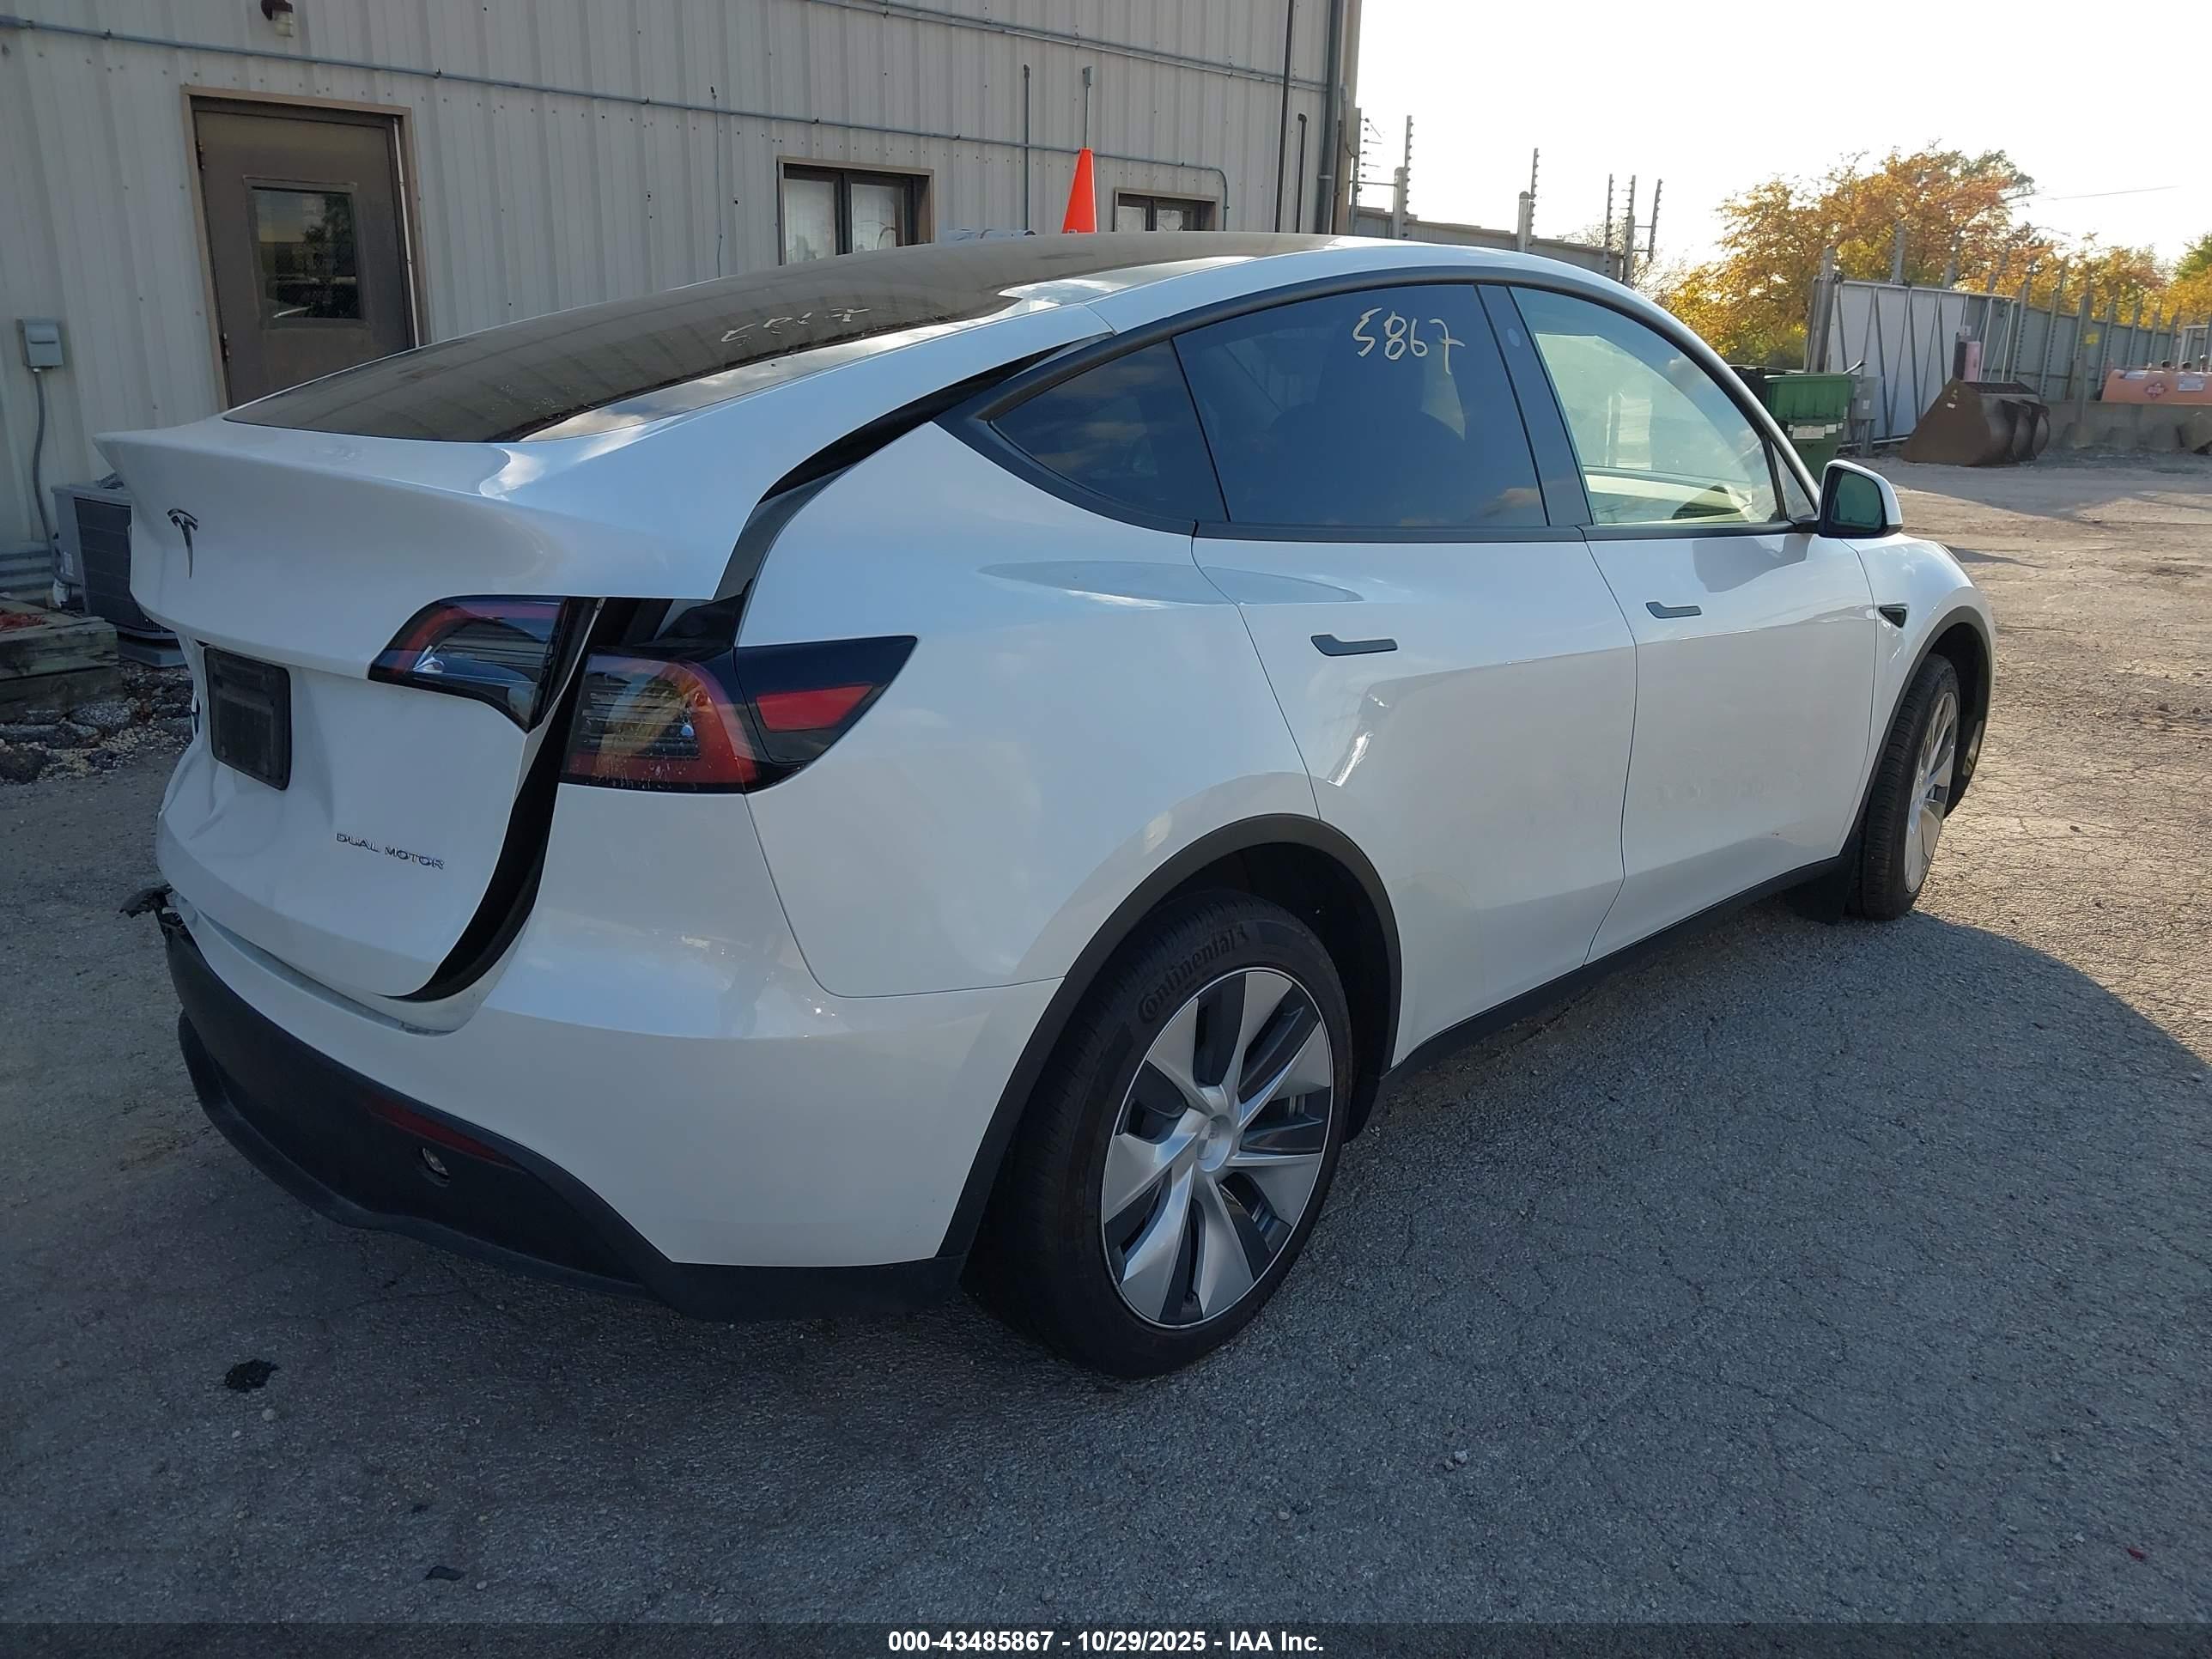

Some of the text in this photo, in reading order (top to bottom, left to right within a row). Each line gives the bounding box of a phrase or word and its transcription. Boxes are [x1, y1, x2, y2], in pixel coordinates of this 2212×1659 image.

[1352, 307, 1466, 375] 5867
[336, 832, 444, 870] DUAL MOTOR
[1138, 928, 1237, 1024] Continental
